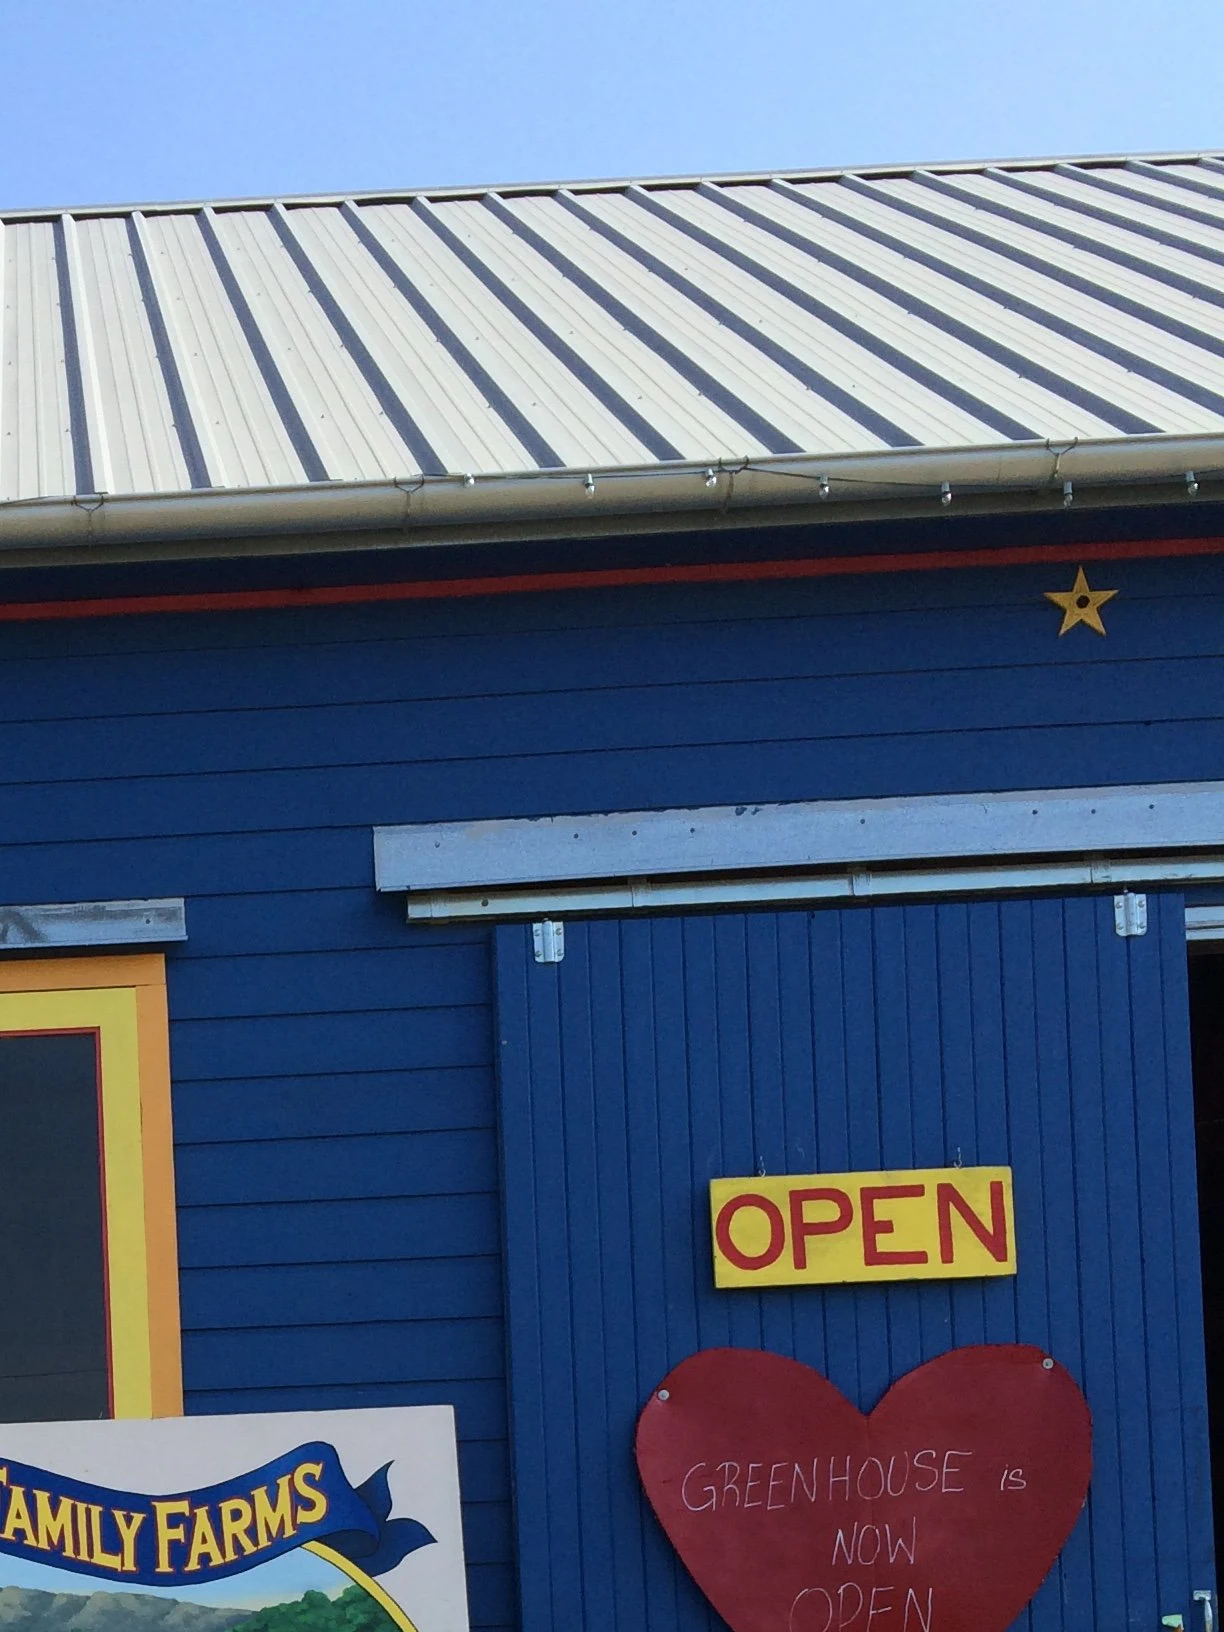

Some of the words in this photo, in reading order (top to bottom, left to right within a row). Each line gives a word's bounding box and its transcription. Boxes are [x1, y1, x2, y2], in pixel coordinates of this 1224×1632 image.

[715, 1180, 1009, 1271] OPEN
[150, 1461, 328, 1573] FARMS
[680, 1448, 973, 1512] GREENHOUSE
[999, 1464, 1027, 1491] is
[831, 1516, 917, 1567] NOW
